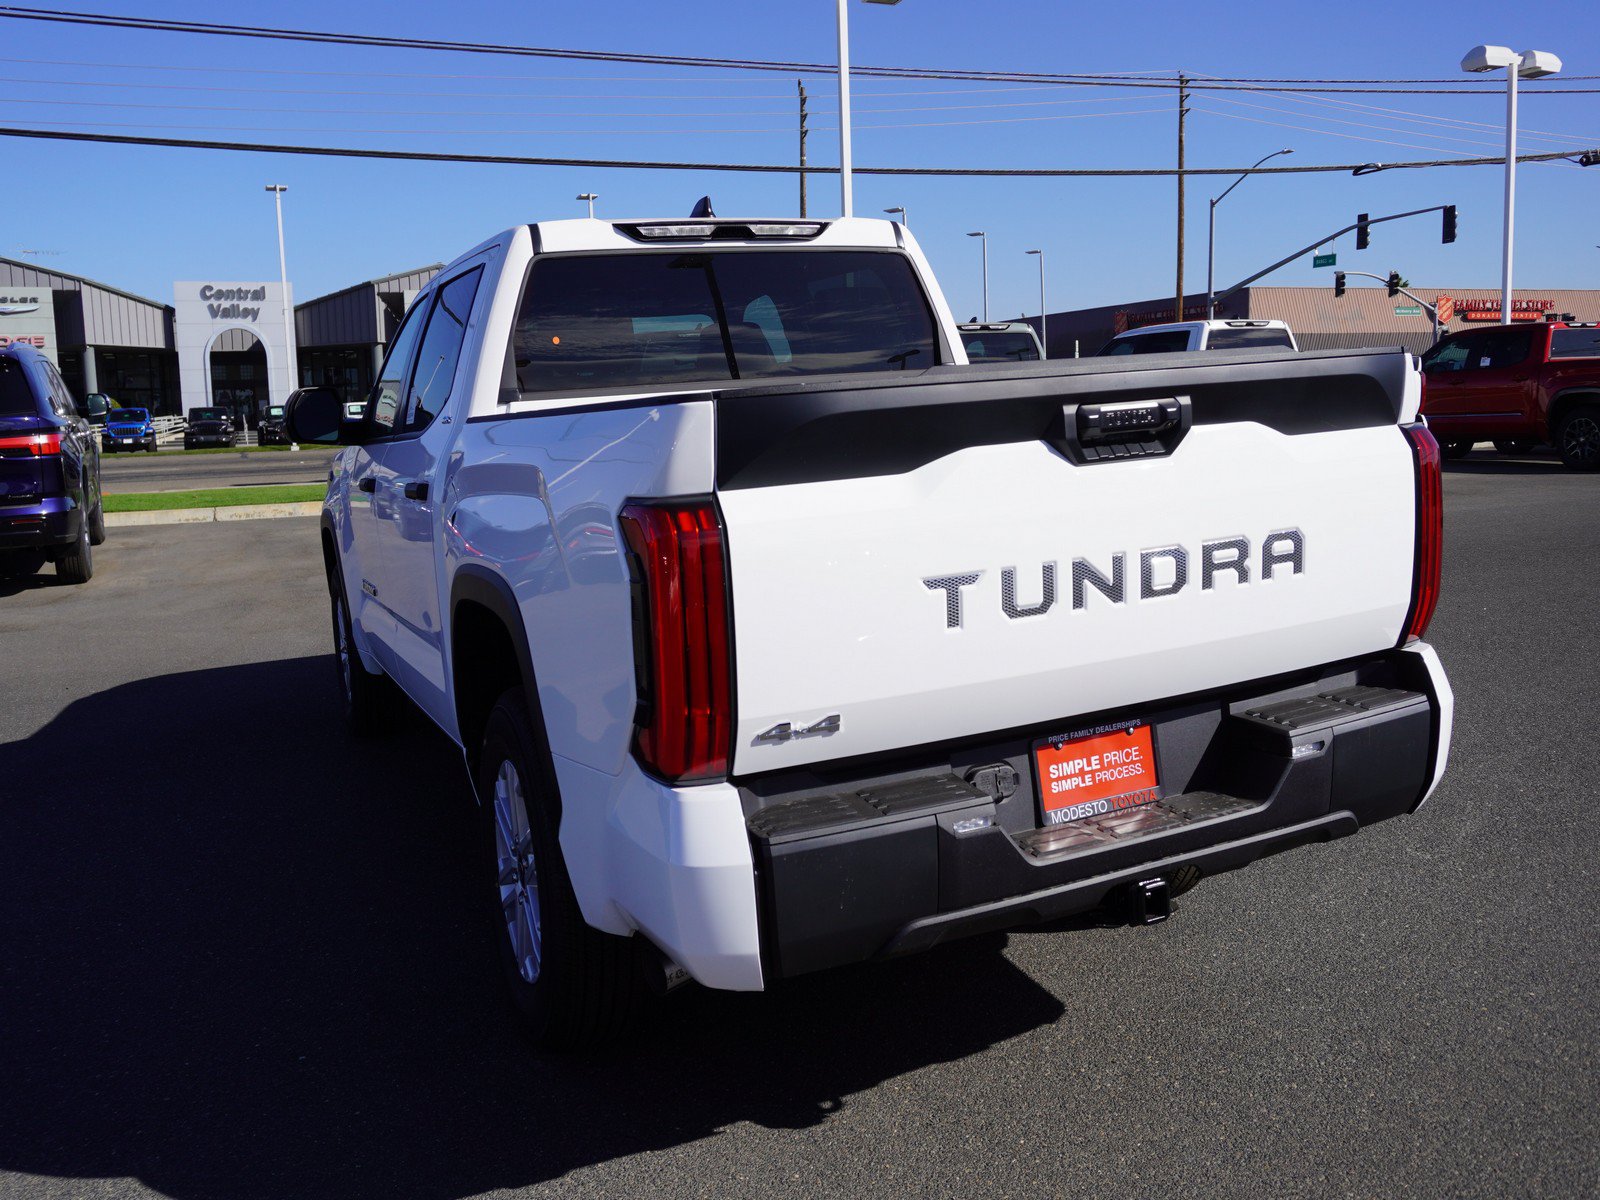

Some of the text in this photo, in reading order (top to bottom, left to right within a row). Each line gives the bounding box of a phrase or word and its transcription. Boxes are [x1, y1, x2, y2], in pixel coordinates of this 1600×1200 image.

[200, 285, 265, 301] Central
[1454, 299, 1488, 311] FAMILY
[1527, 299, 1555, 311] STORE
[207, 303, 260, 322] Valley
[1106, 409, 1155, 426] TOYOTA
[920, 526, 1306, 633] TUNDRA
[1048, 719, 1141, 743] PRICE FAMILY DEALERSHIPS
[1049, 746, 1143, 779] SIMPLE PRICE.
[1051, 763, 1145, 793] SIMPLE PROCESS.
[1051, 800, 1108, 824] MODESTO
[1110, 789, 1158, 810] TOYOTA
